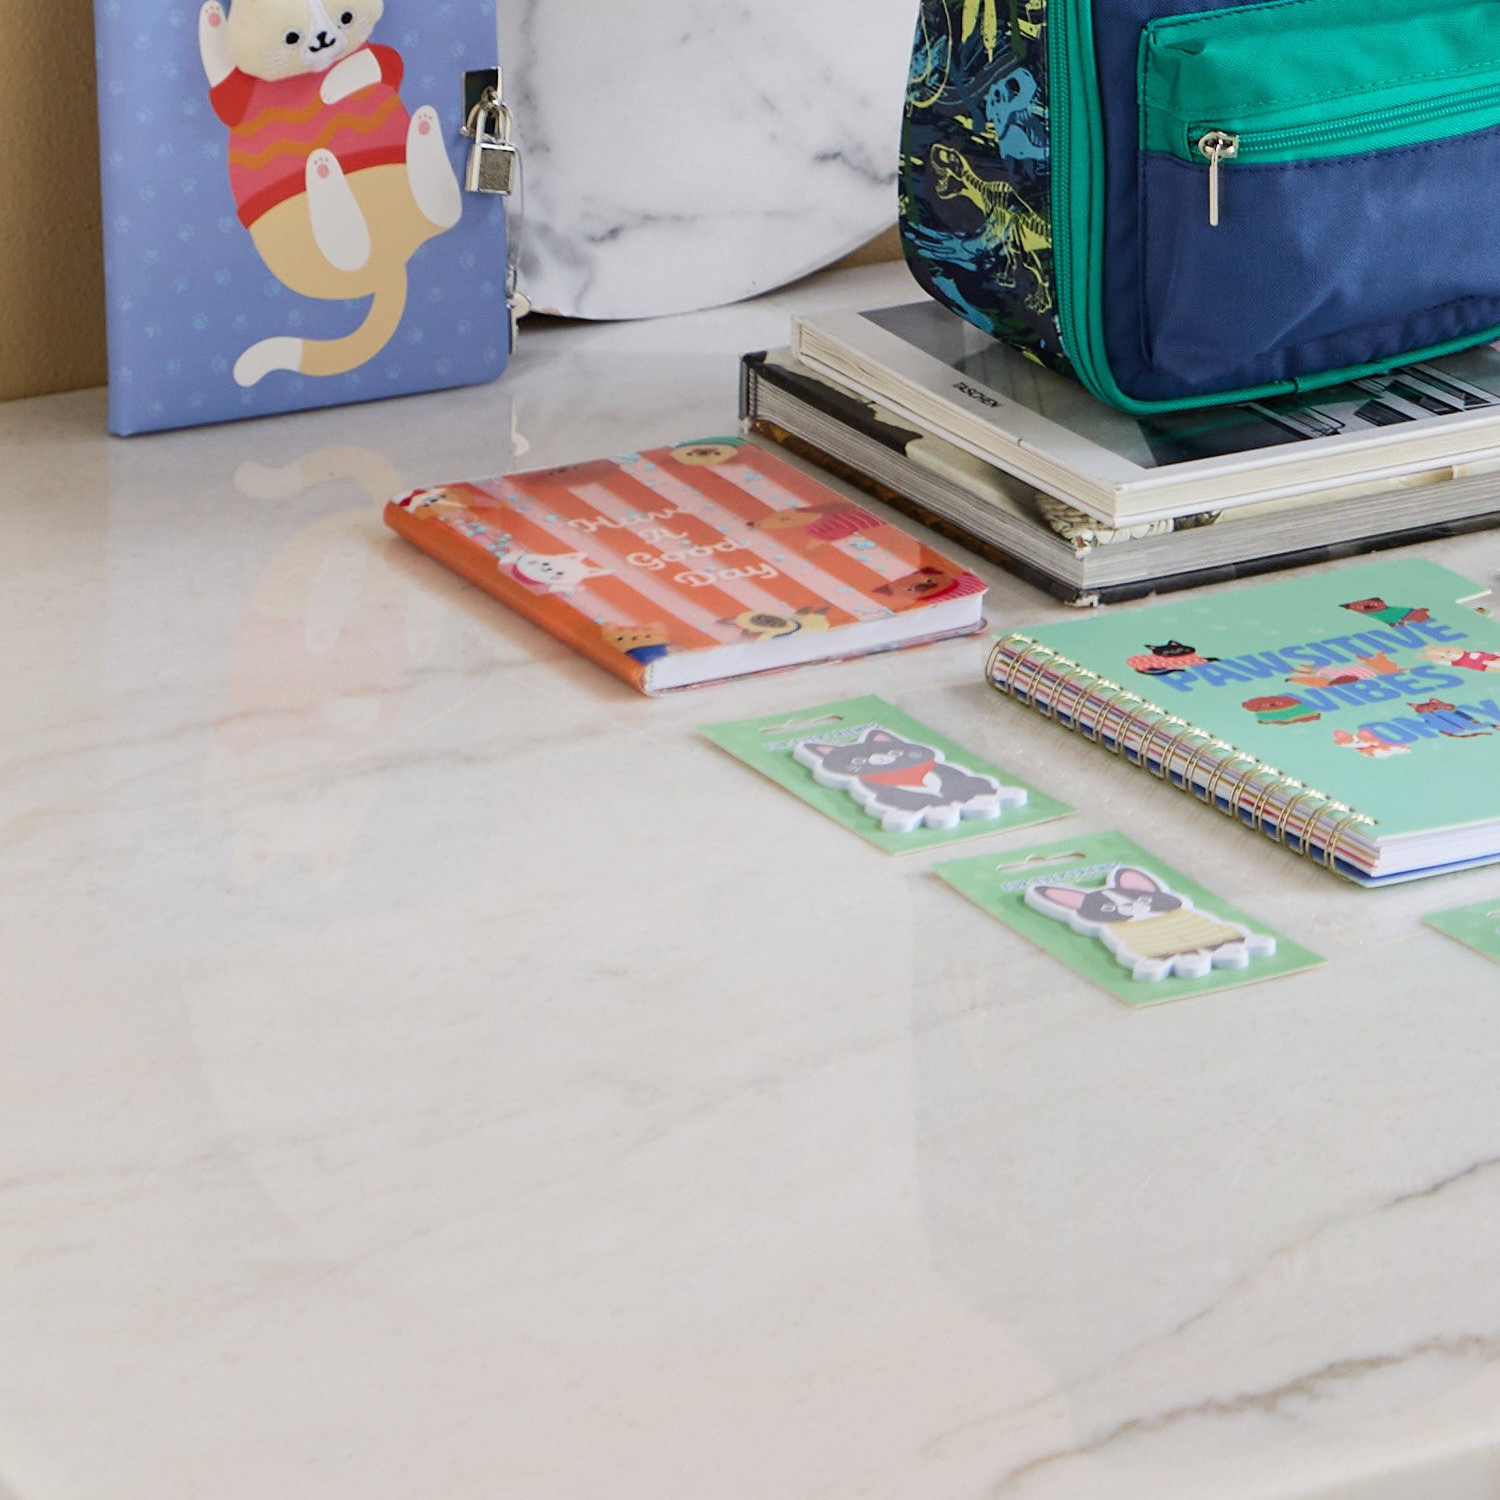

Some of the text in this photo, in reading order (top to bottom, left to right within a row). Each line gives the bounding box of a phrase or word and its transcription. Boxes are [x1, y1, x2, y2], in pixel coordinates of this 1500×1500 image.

[626, 536, 743, 571] Good
[673, 562, 780, 588] Day
[1154, 618, 1468, 692] PAWSITIVE
[1289, 664, 1464, 712] VIBES
